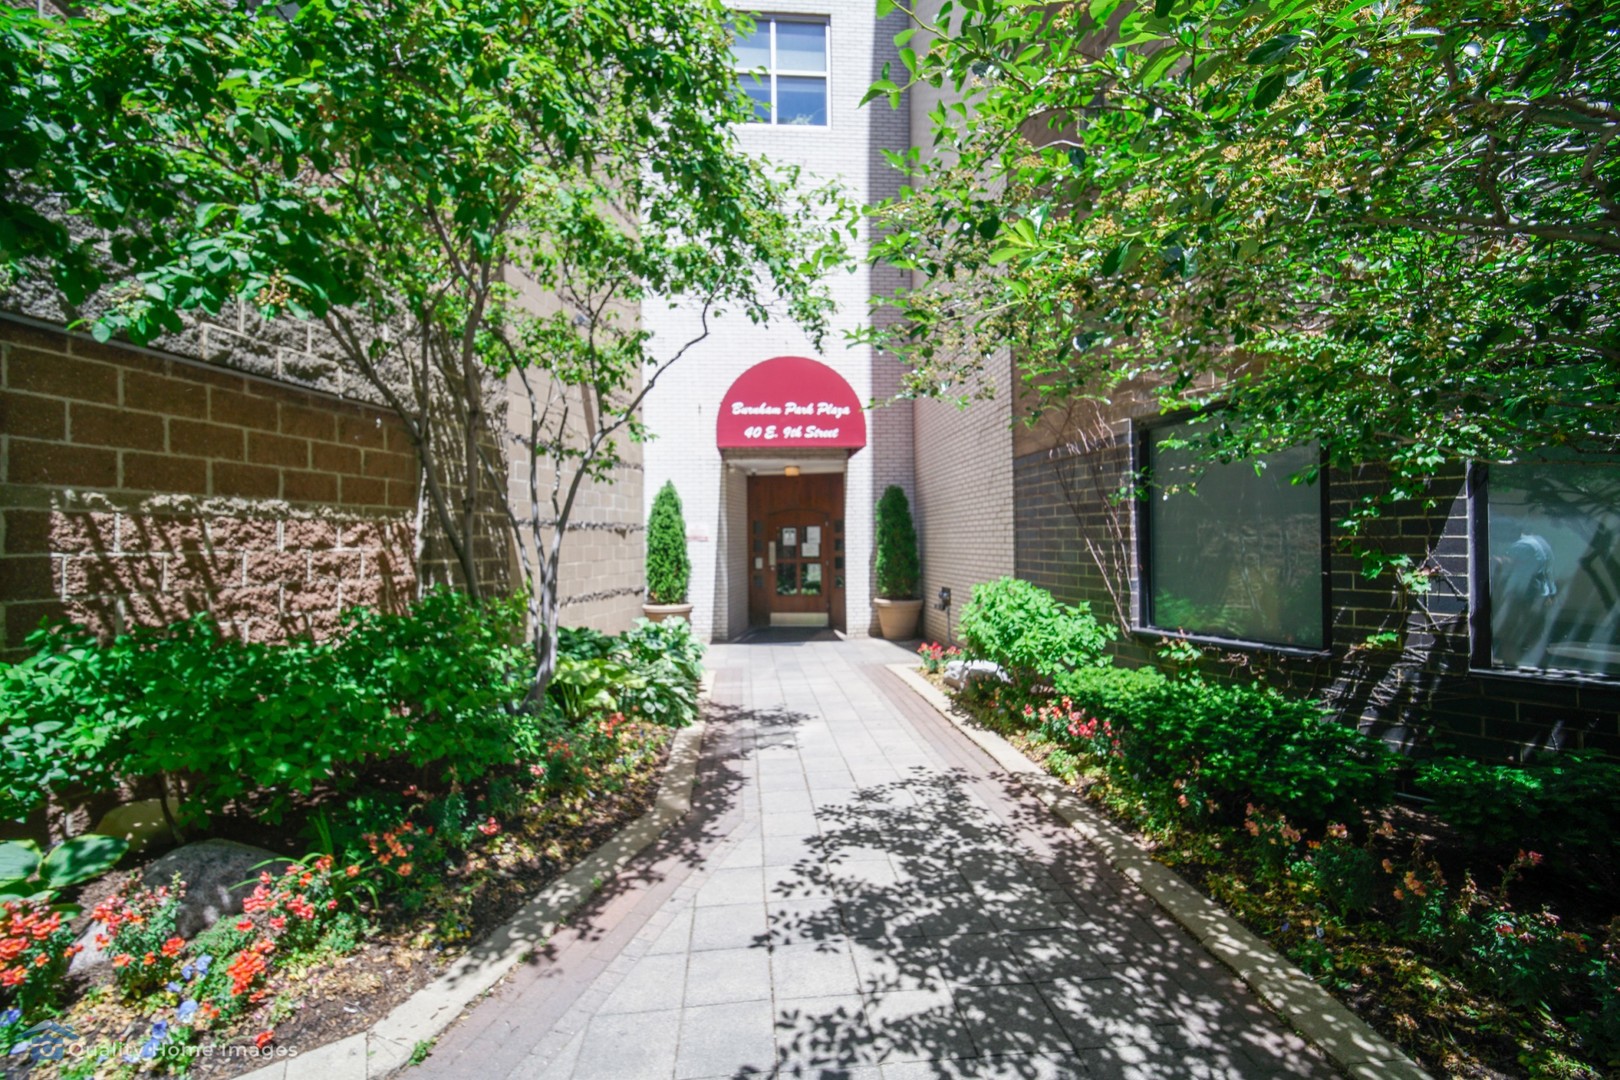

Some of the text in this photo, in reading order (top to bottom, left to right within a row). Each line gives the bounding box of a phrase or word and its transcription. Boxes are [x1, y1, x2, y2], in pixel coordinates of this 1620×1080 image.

[731, 401, 851, 419] Burnham Park Plaza
[744, 425, 840, 439] 40 E. 9th Street
